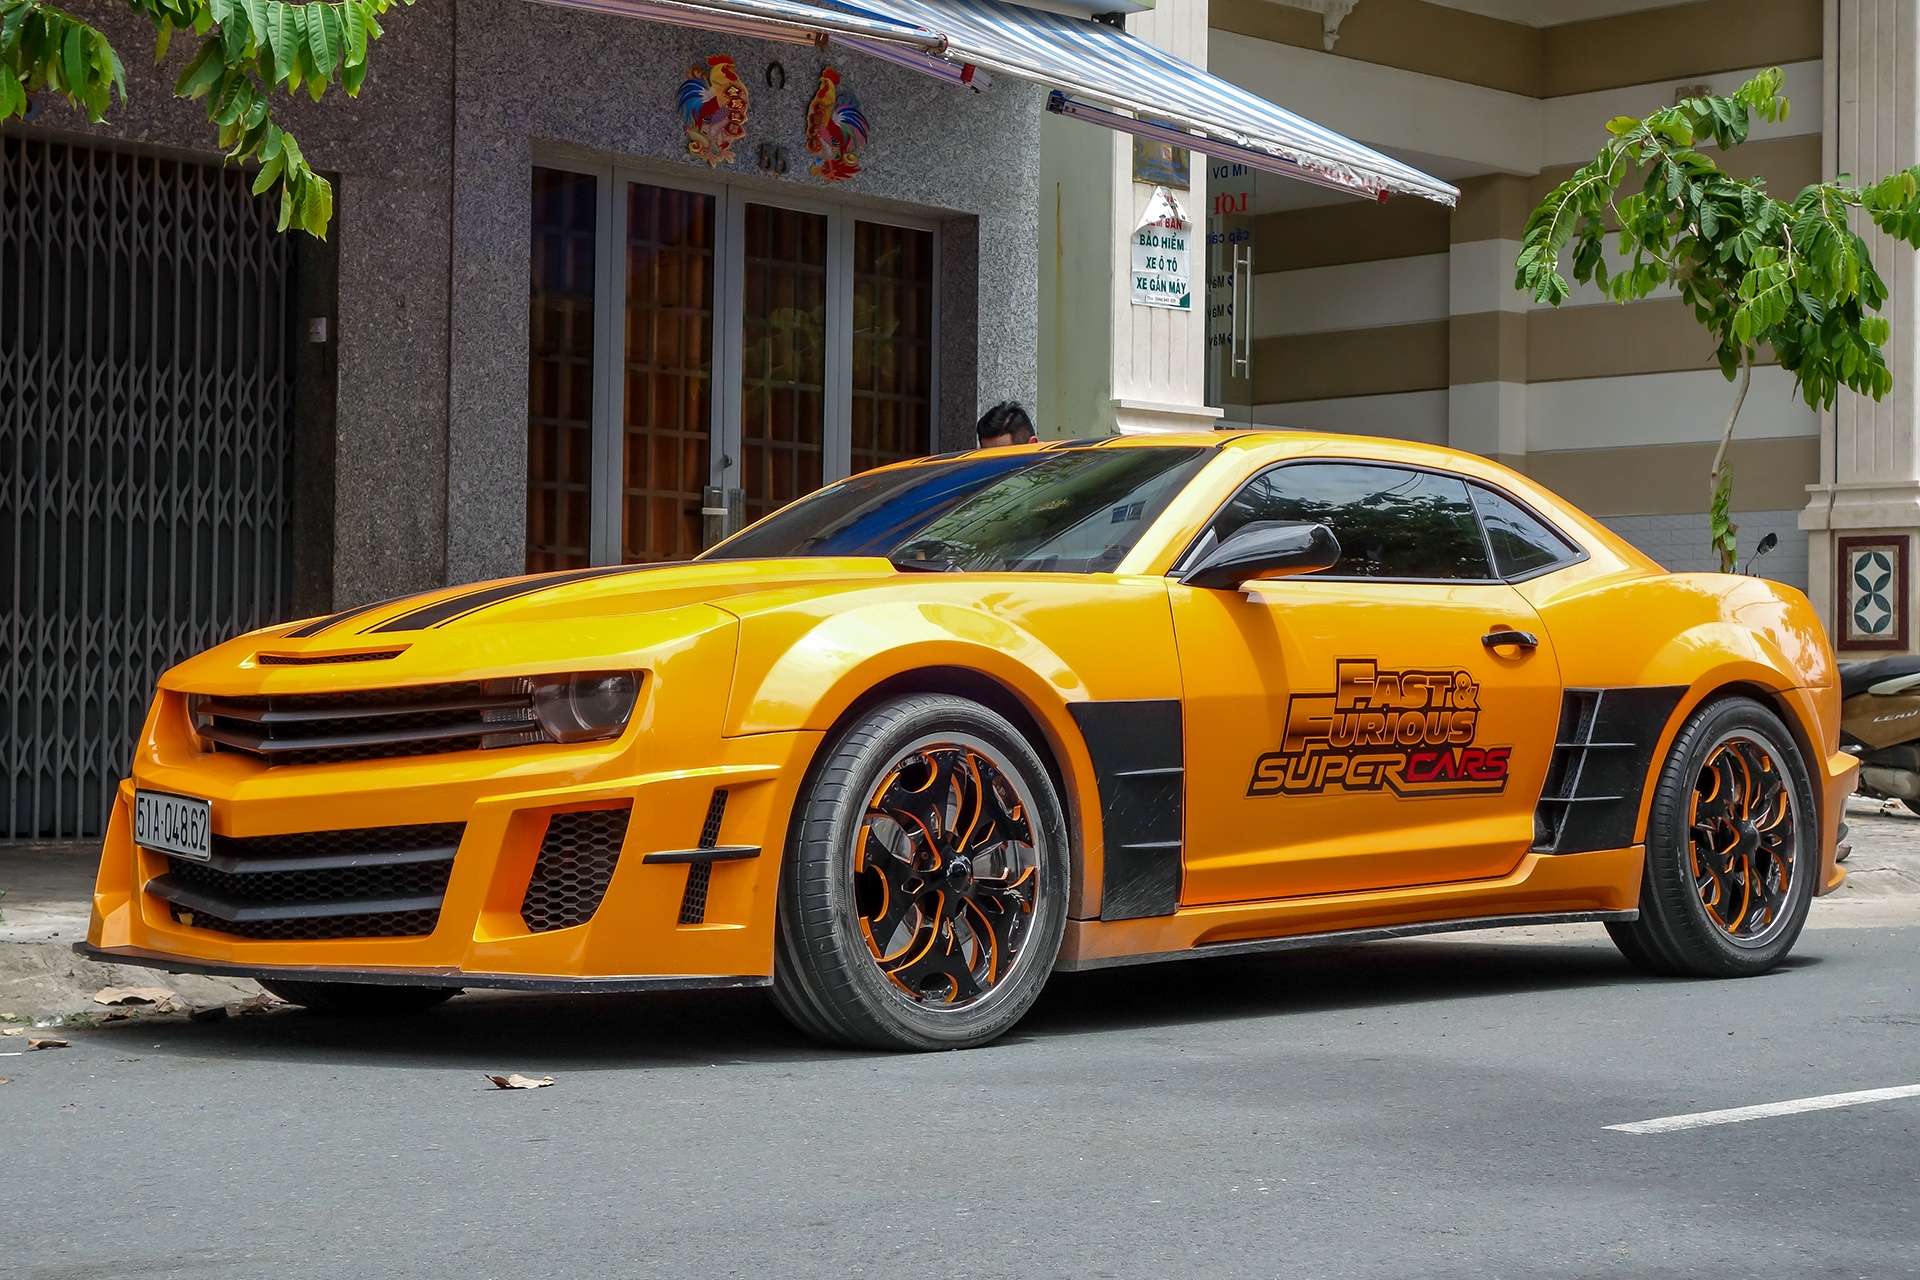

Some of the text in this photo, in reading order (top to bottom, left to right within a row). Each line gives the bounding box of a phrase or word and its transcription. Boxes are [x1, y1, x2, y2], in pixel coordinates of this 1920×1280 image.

[1139, 231, 1184, 251] BẢO HIỂM
[1146, 255, 1178, 272] XE Ô TÔ
[1136, 274, 1186, 295] XE GẮN MÁY
[1283, 697, 1476, 752] FURIOUS
